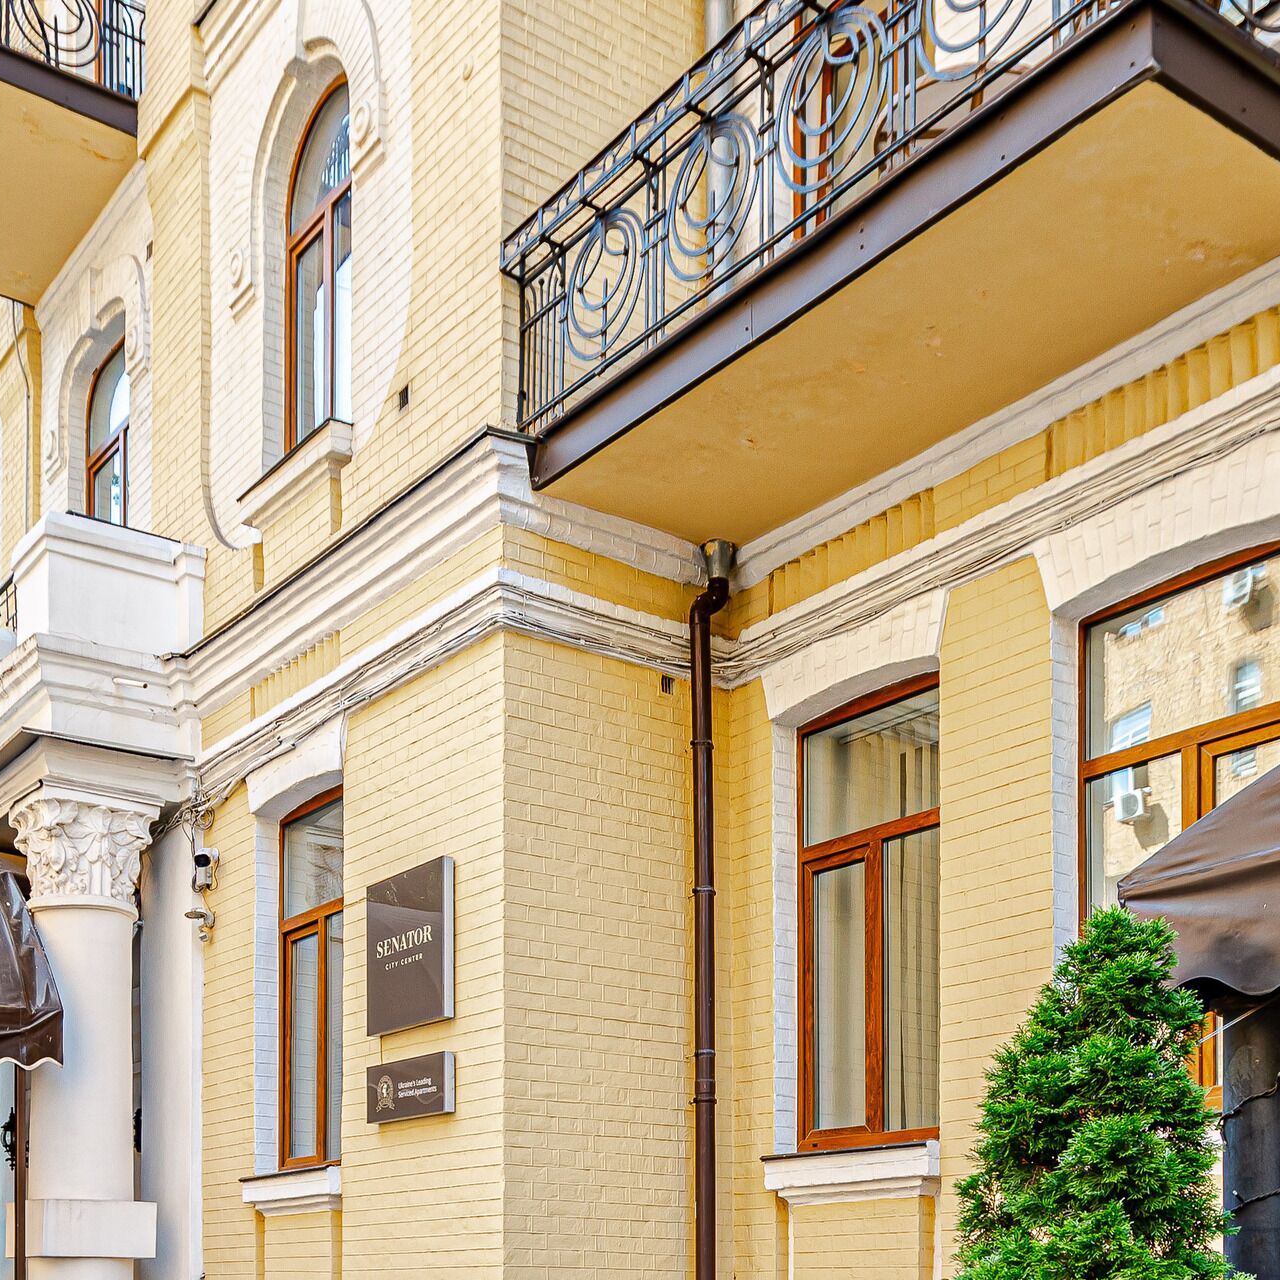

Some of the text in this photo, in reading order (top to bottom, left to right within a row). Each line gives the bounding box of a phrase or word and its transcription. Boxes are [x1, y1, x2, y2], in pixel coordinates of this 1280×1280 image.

[376, 925, 433, 959] SENATOR
[385, 952, 423, 971] CITY CENTER
